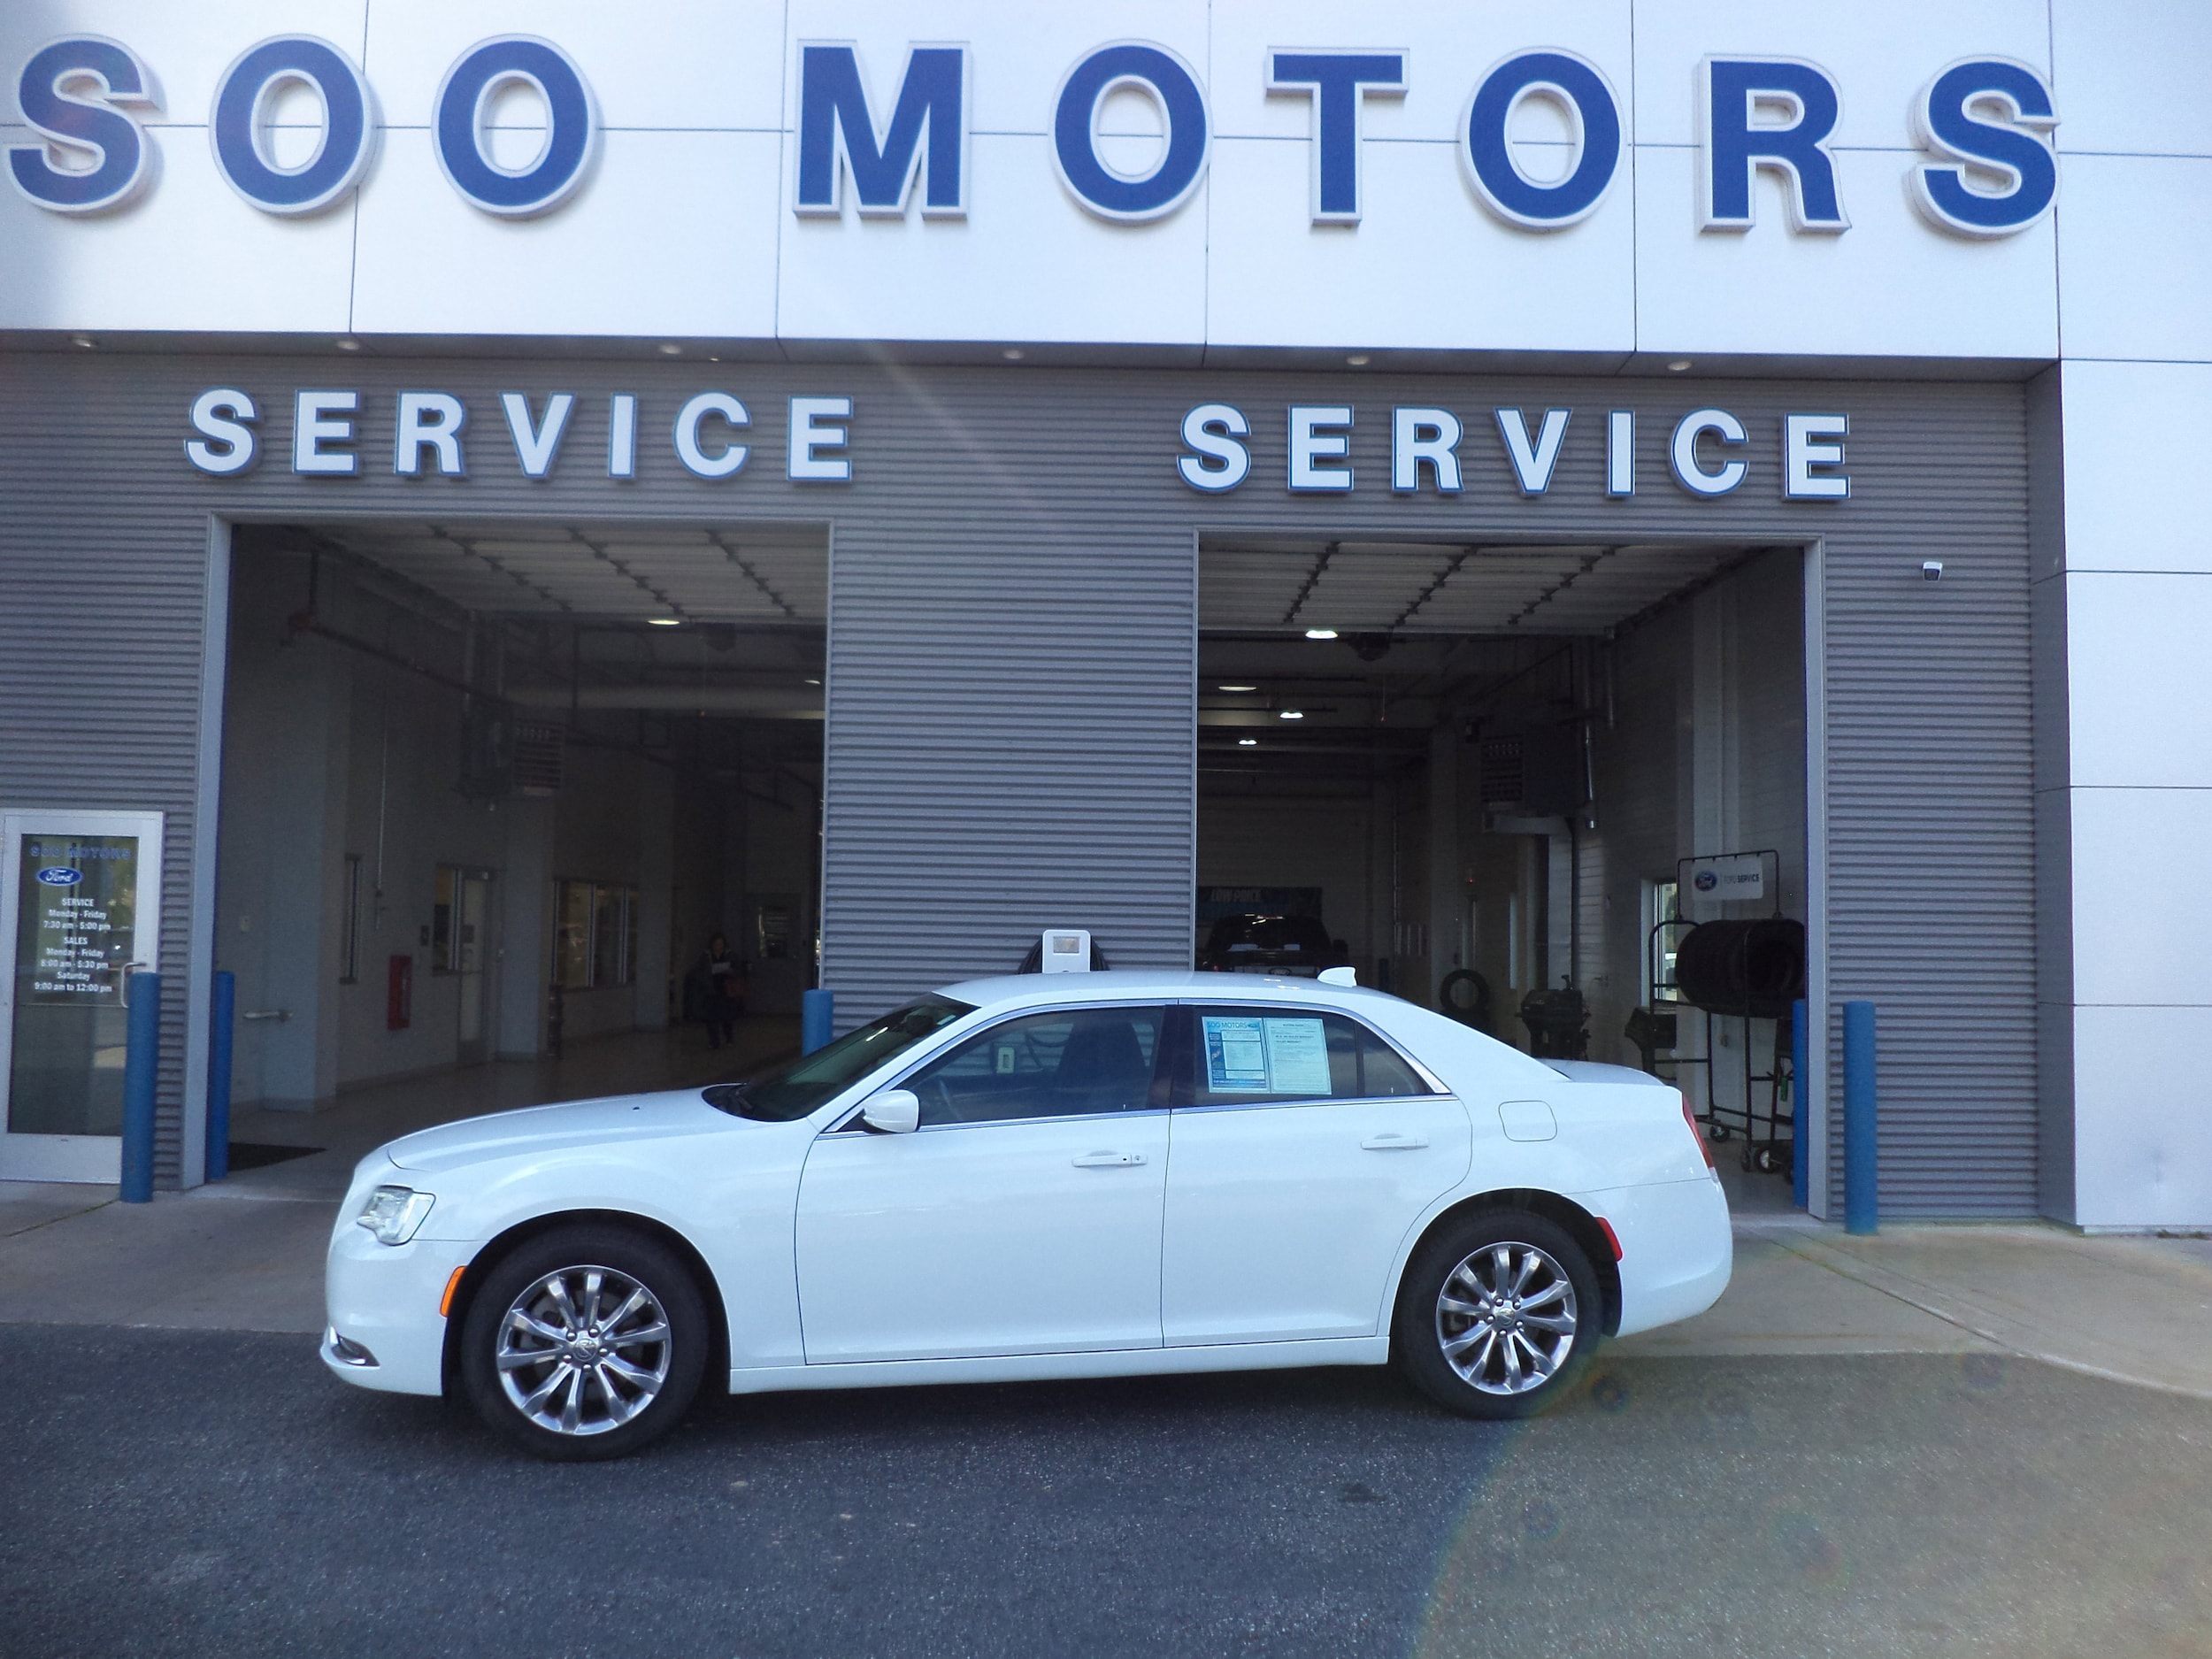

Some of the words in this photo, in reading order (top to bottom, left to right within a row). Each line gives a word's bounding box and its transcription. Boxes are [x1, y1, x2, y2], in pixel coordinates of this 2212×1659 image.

[7, 33, 600, 219] SOO
[792, 37, 2060, 240] MOTORS
[184, 388, 855, 482] SERVICE
[1178, 402, 1851, 499] SERVICE
[45, 869, 74, 883] Ford
[62, 897, 95, 907] SERVICE
[49, 909, 78, 919] Monday
[84, 910, 108, 920] Friday
[80, 921, 97, 930] 5:00
[64, 936, 88, 945] SALES
[47, 948, 76, 958] Monday
[82, 949, 105, 958] Friday
[58, 971, 90, 981] Saturday
[76, 983, 99, 992] 12:00
